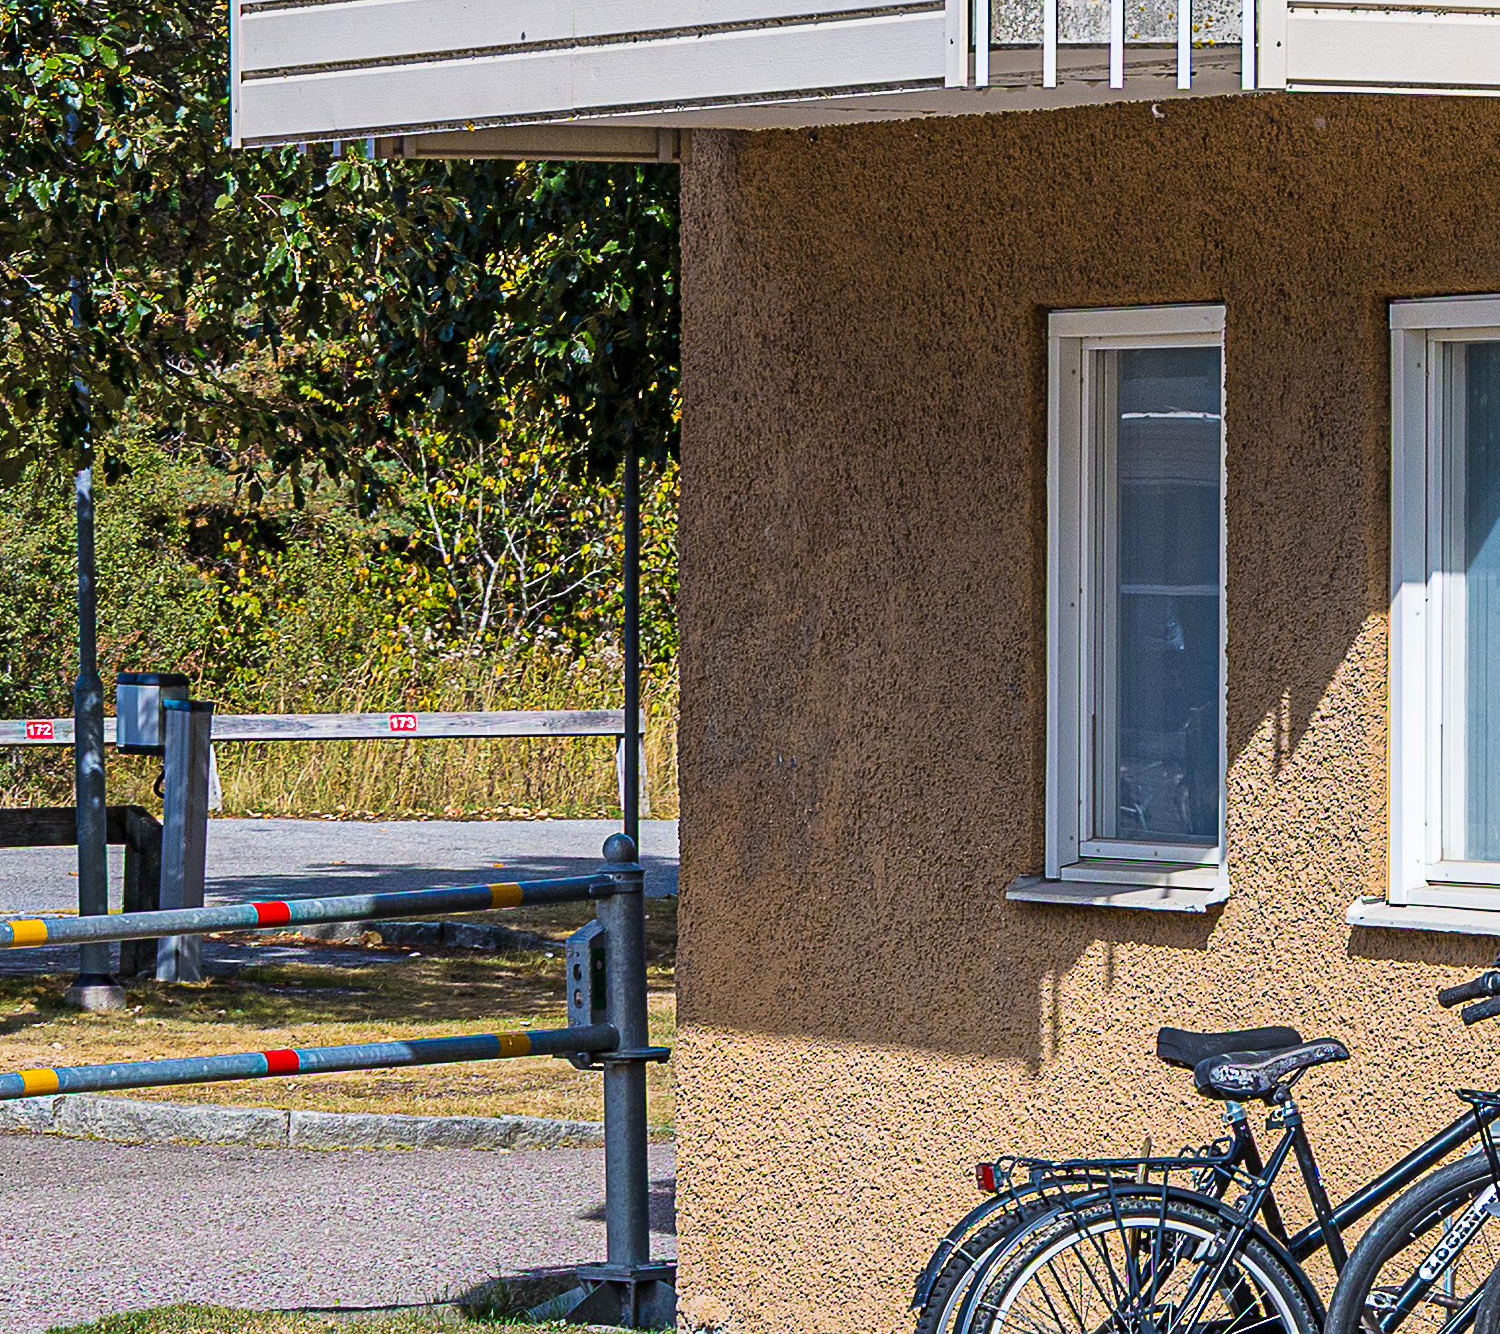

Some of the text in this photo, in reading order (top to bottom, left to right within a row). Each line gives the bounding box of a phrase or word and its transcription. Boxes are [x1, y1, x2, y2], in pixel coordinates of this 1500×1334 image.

[390, 716, 416, 729] 173
[27, 723, 52, 736] 172
[1423, 1208, 1483, 1275] LOGAN
